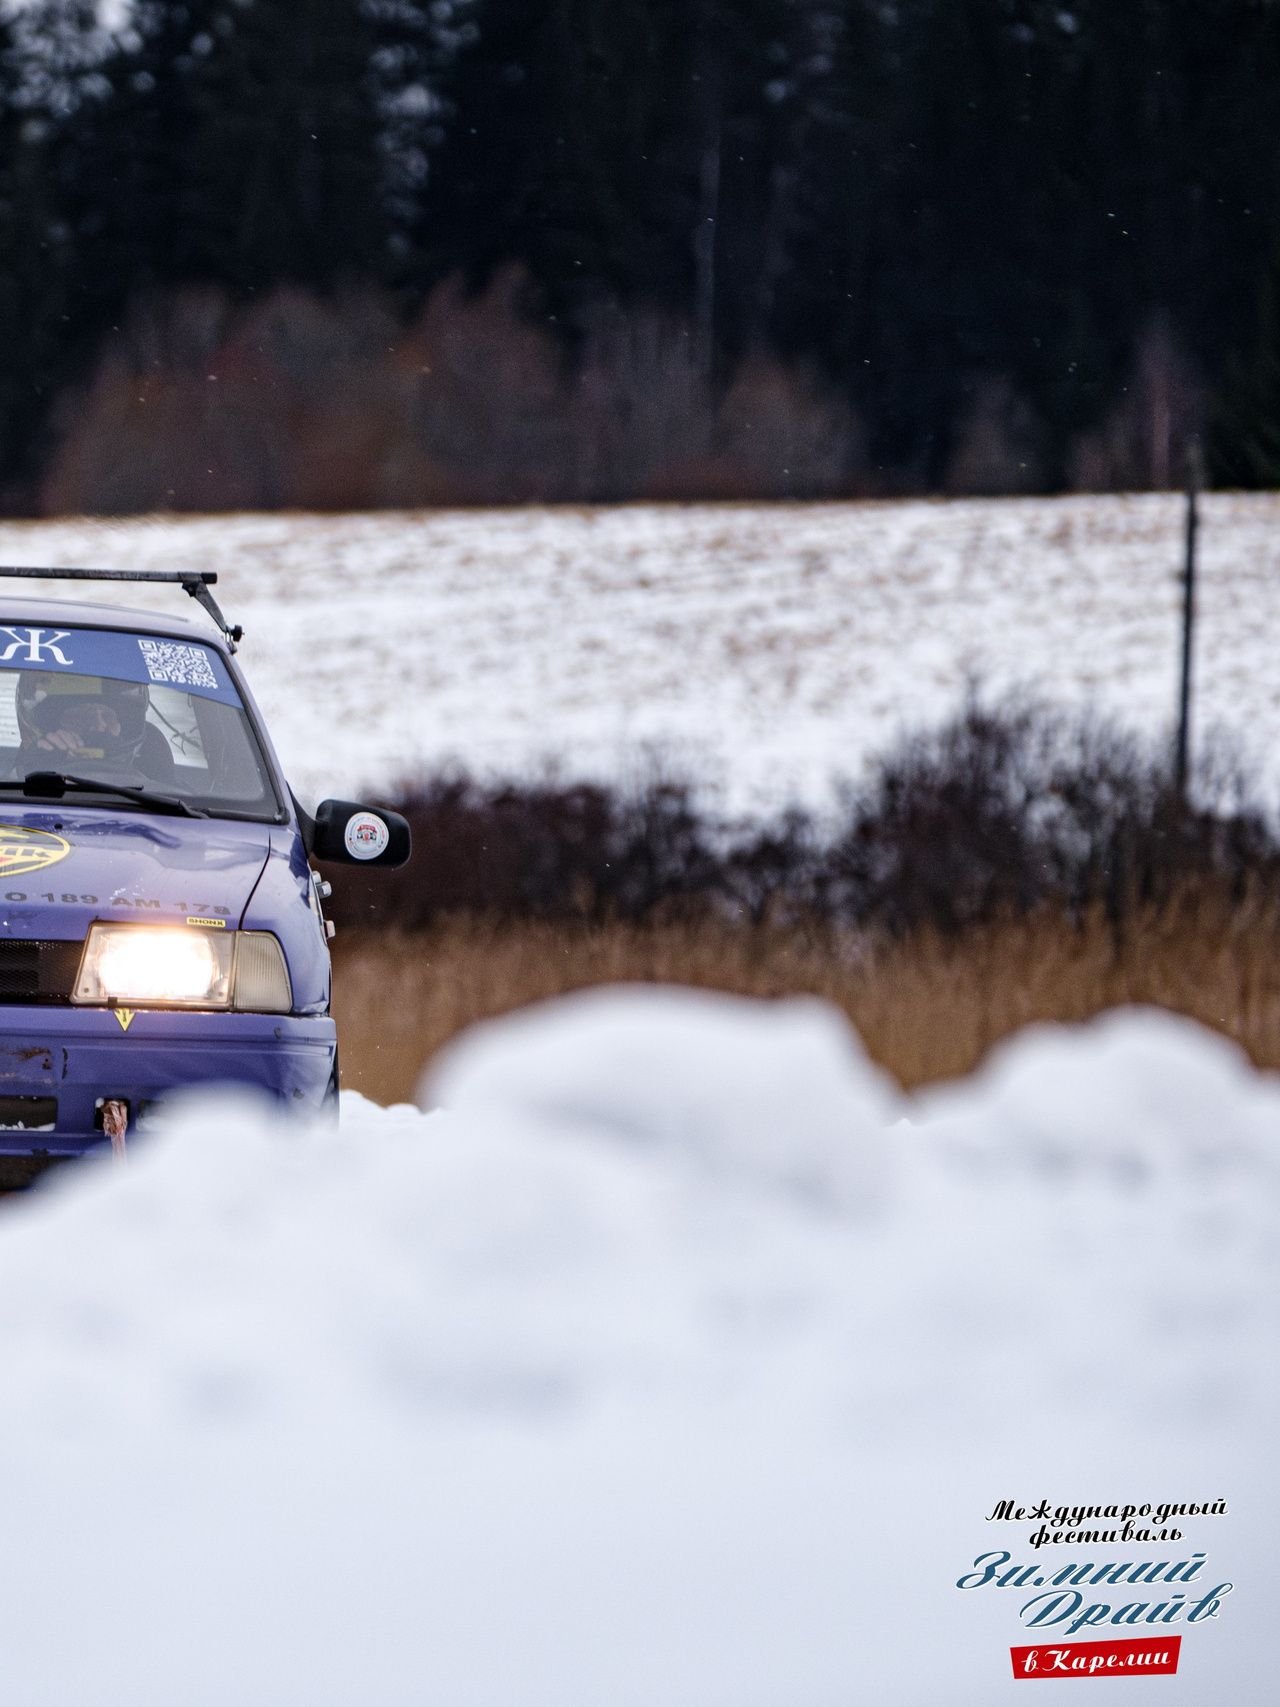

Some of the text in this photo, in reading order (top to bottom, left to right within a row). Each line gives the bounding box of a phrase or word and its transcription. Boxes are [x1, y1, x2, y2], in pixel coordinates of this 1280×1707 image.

[40, 892, 100, 905] 189
[173, 901, 232, 916] 178
[188, 918, 224, 926] SHONX
